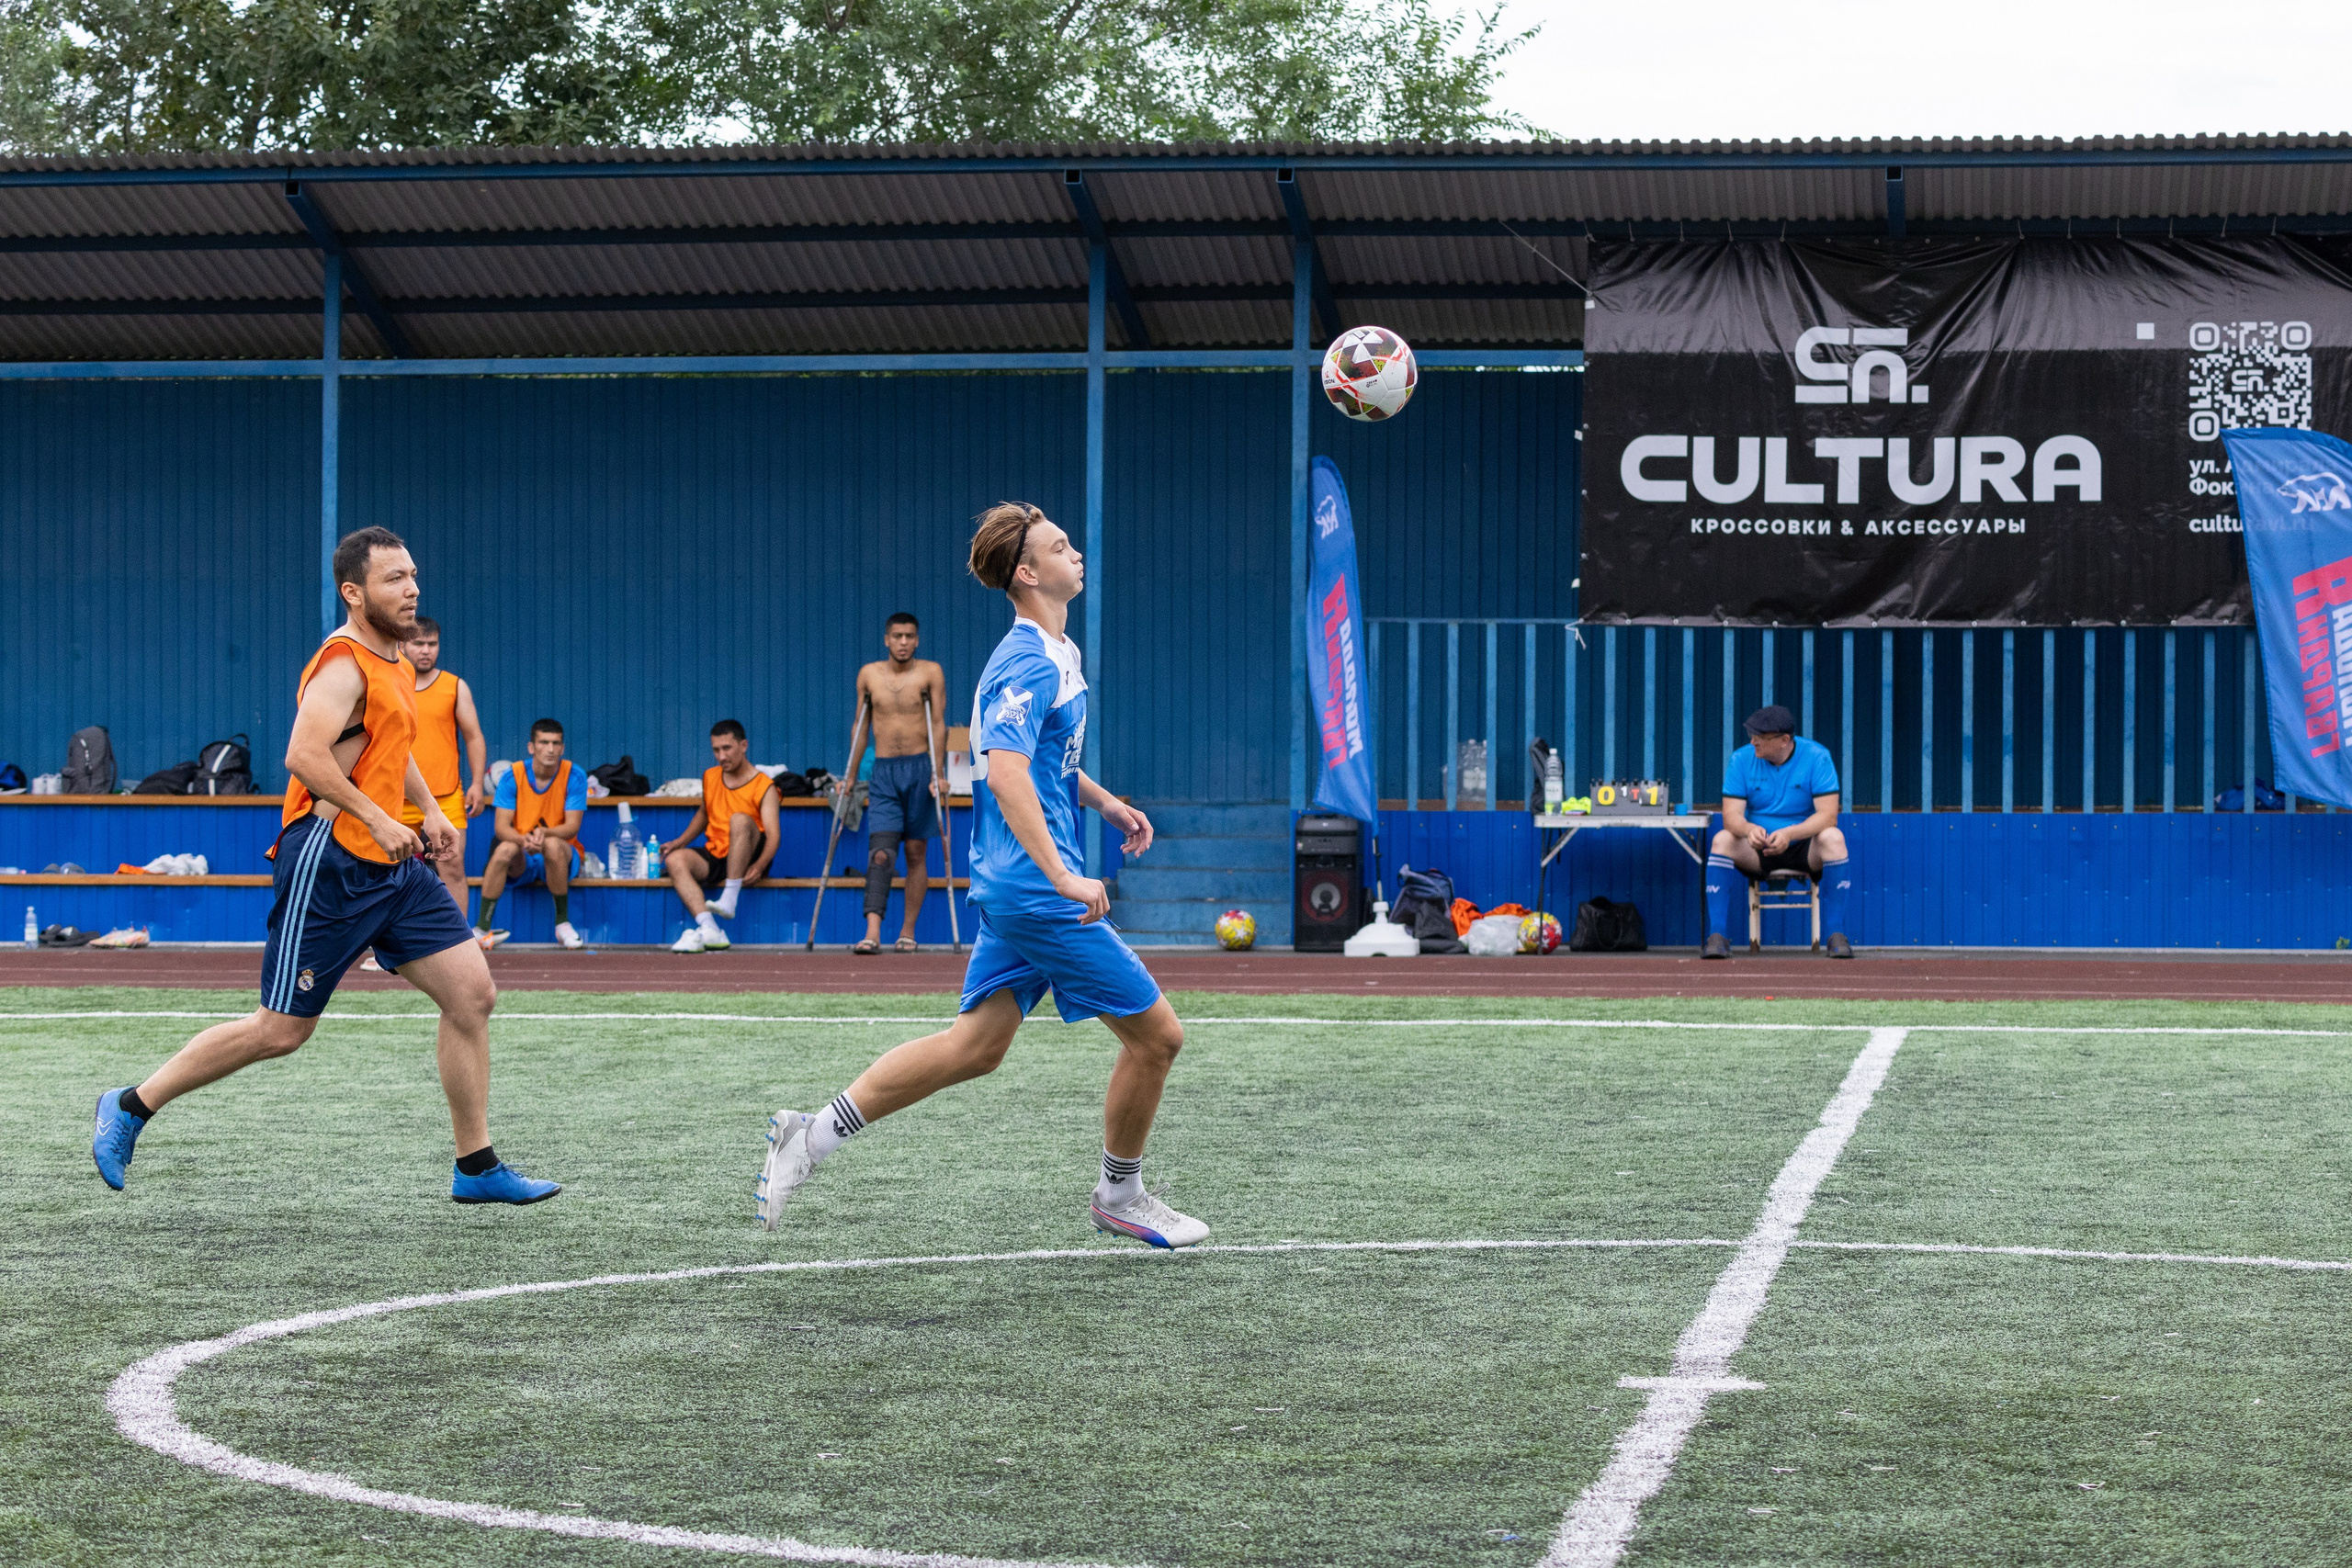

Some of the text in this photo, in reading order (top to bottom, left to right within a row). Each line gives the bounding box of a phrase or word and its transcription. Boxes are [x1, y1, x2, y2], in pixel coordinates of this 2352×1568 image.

[1620, 434, 2103, 504] CULTURA
[2188, 459, 2221, 479] ул.
[2188, 477, 2238, 496] Фок
[1690, 517, 2027, 536] КРОССОВКИ & АКСЕССУАРЫ
[2188, 513, 2245, 533] cultu
[1597, 785, 1615, 806] 0
[1646, 786, 1658, 806] 1
